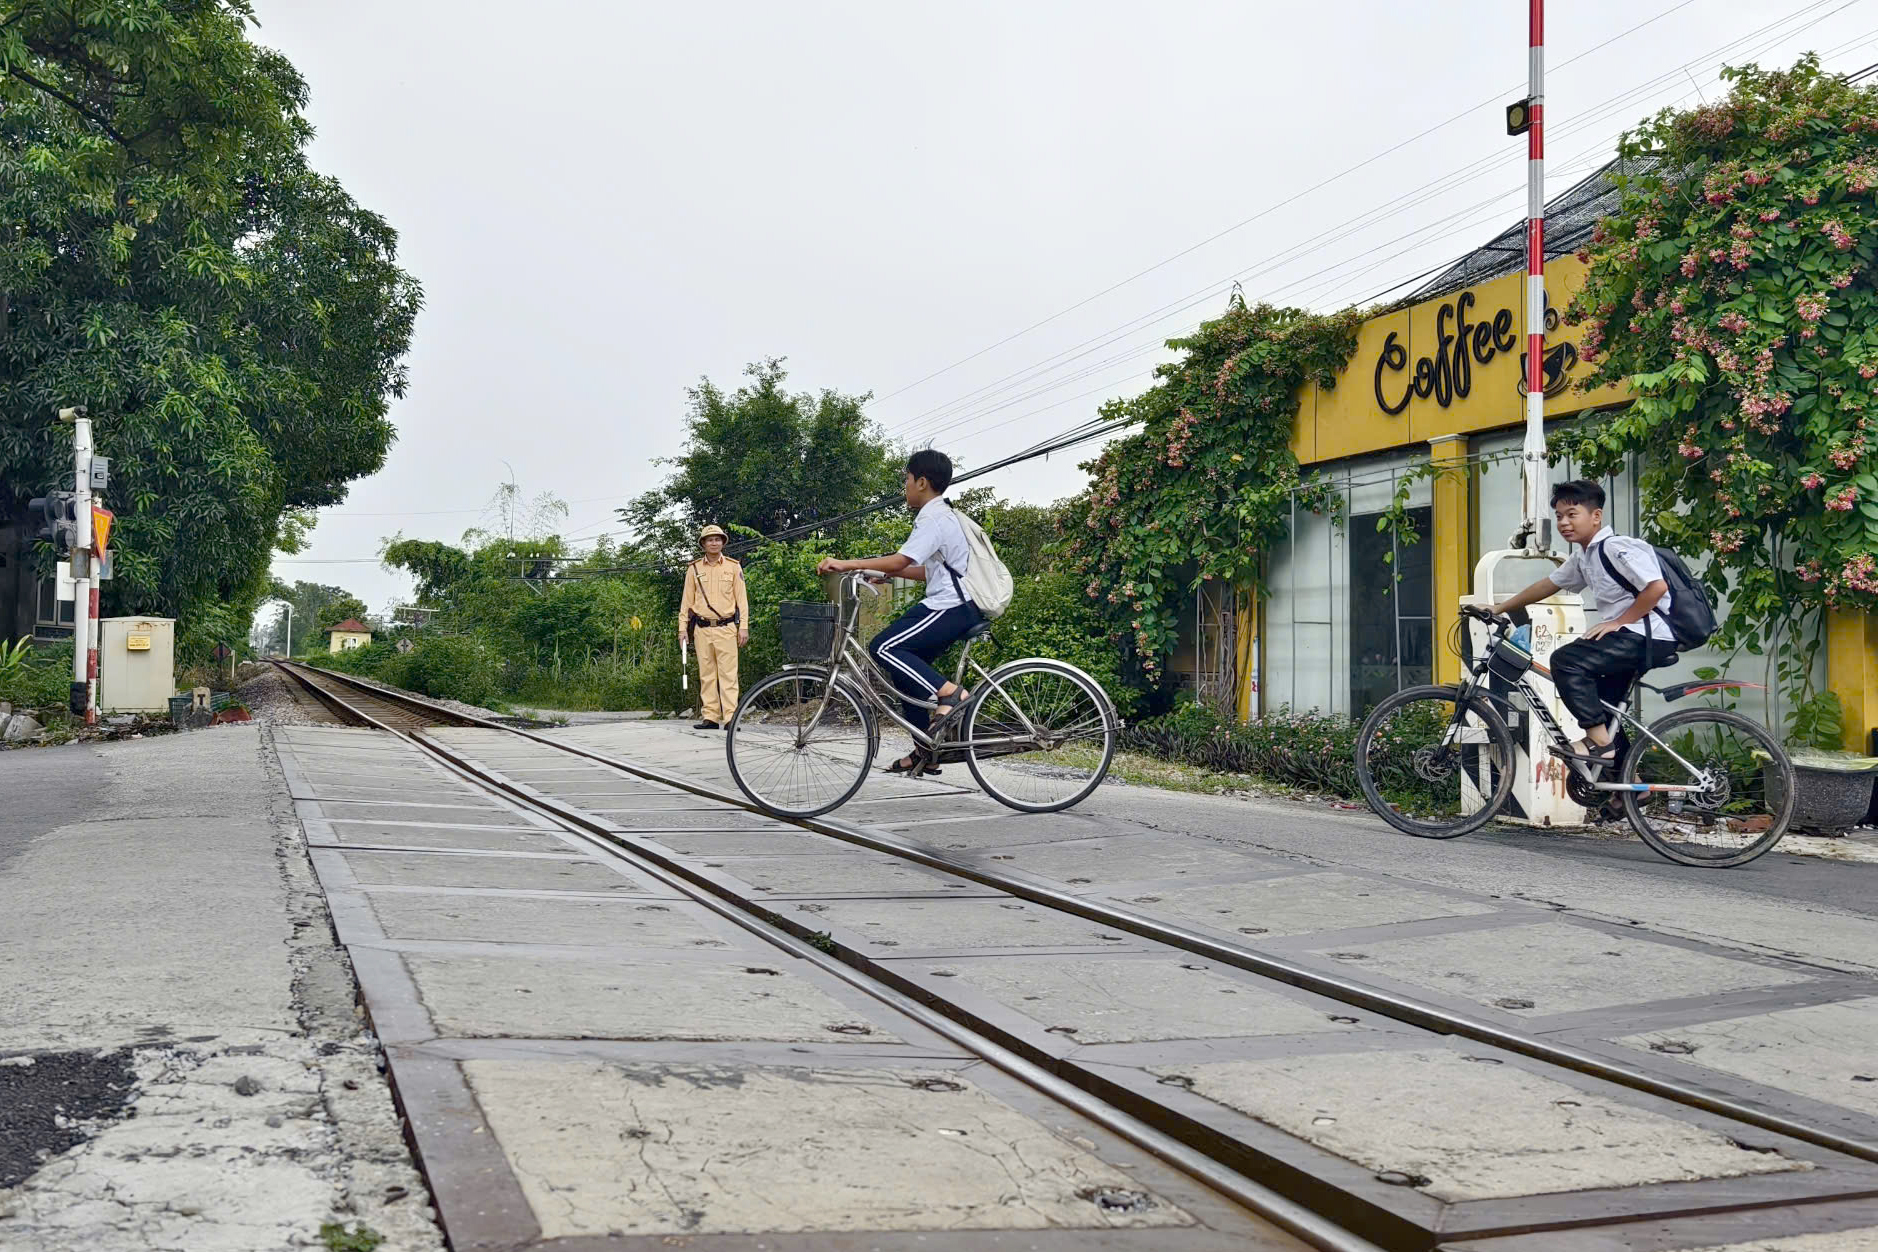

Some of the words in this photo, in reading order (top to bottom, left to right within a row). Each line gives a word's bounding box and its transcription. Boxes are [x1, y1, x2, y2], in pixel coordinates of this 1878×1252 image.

[1374, 291, 1517, 416] Coffee
[1535, 624, 1547, 638] C2
[197, 694, 206, 705] T
